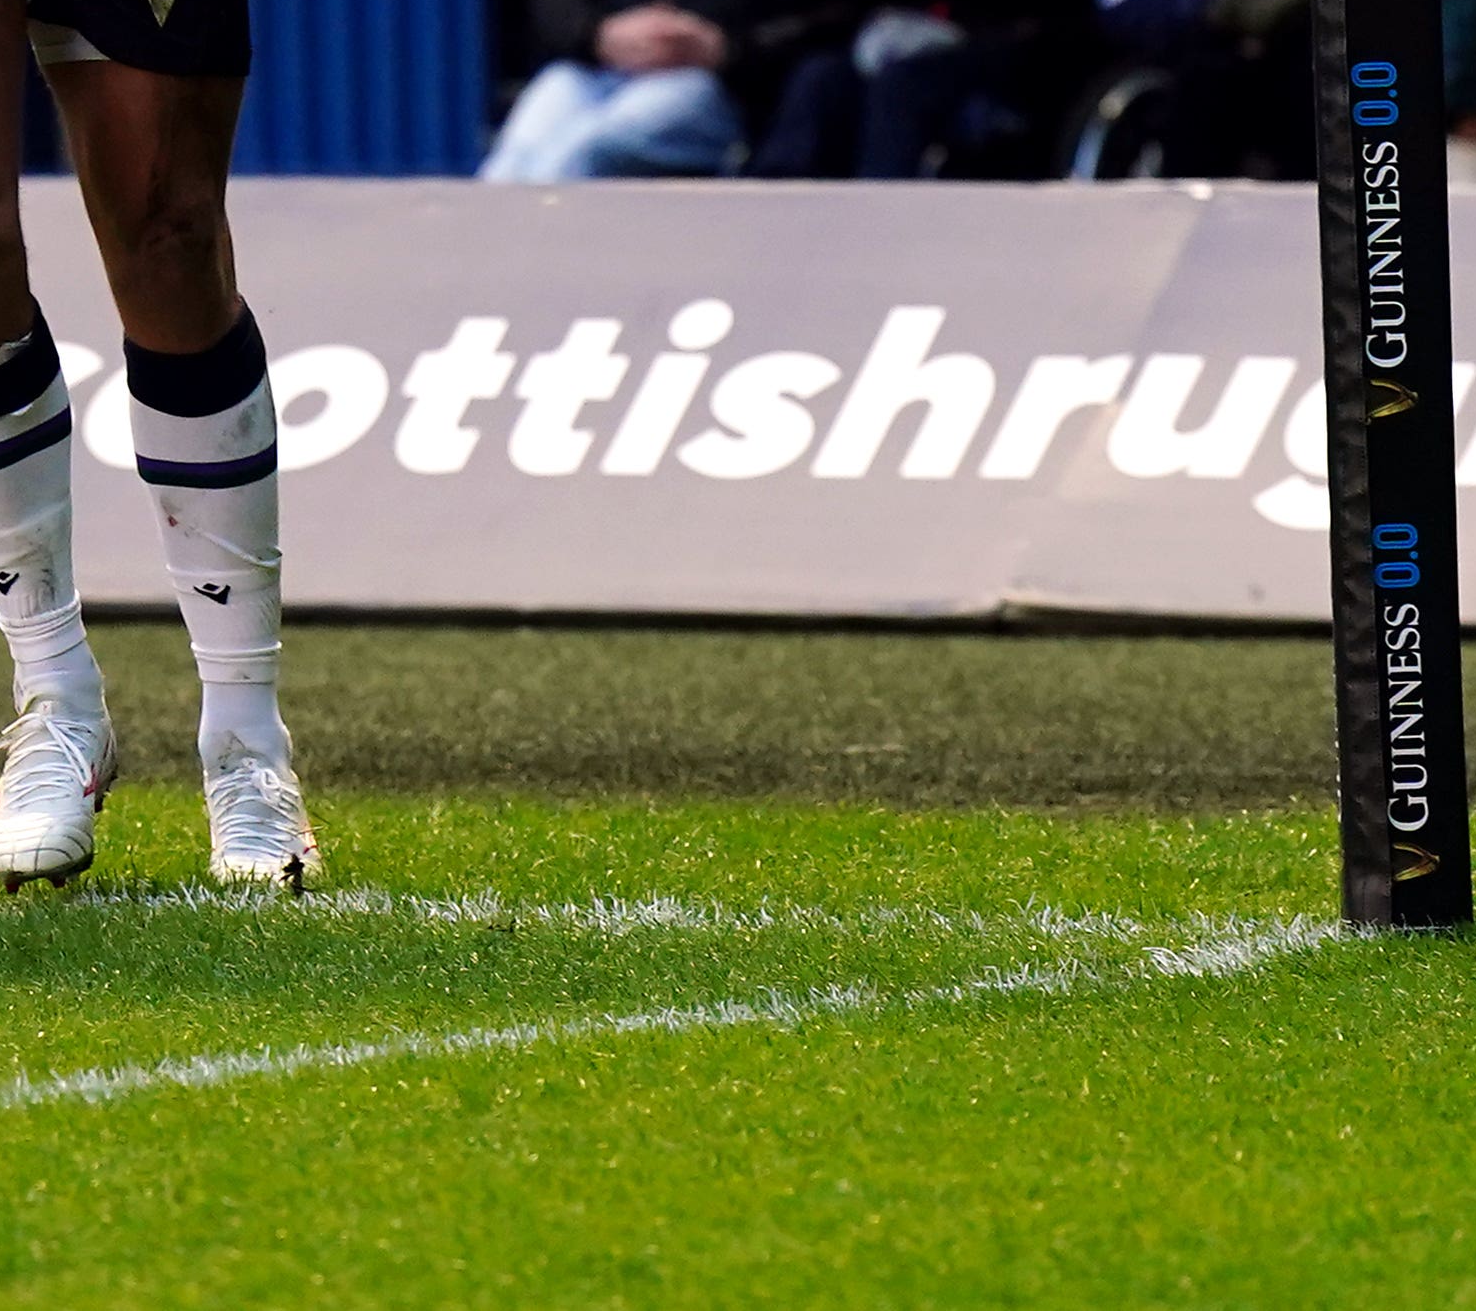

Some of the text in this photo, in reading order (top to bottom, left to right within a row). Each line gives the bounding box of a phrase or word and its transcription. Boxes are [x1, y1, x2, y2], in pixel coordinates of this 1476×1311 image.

[1351, 61, 1408, 369] GUINNESS 0.0
[1372, 523, 1429, 831] GUINNESS 0.0
